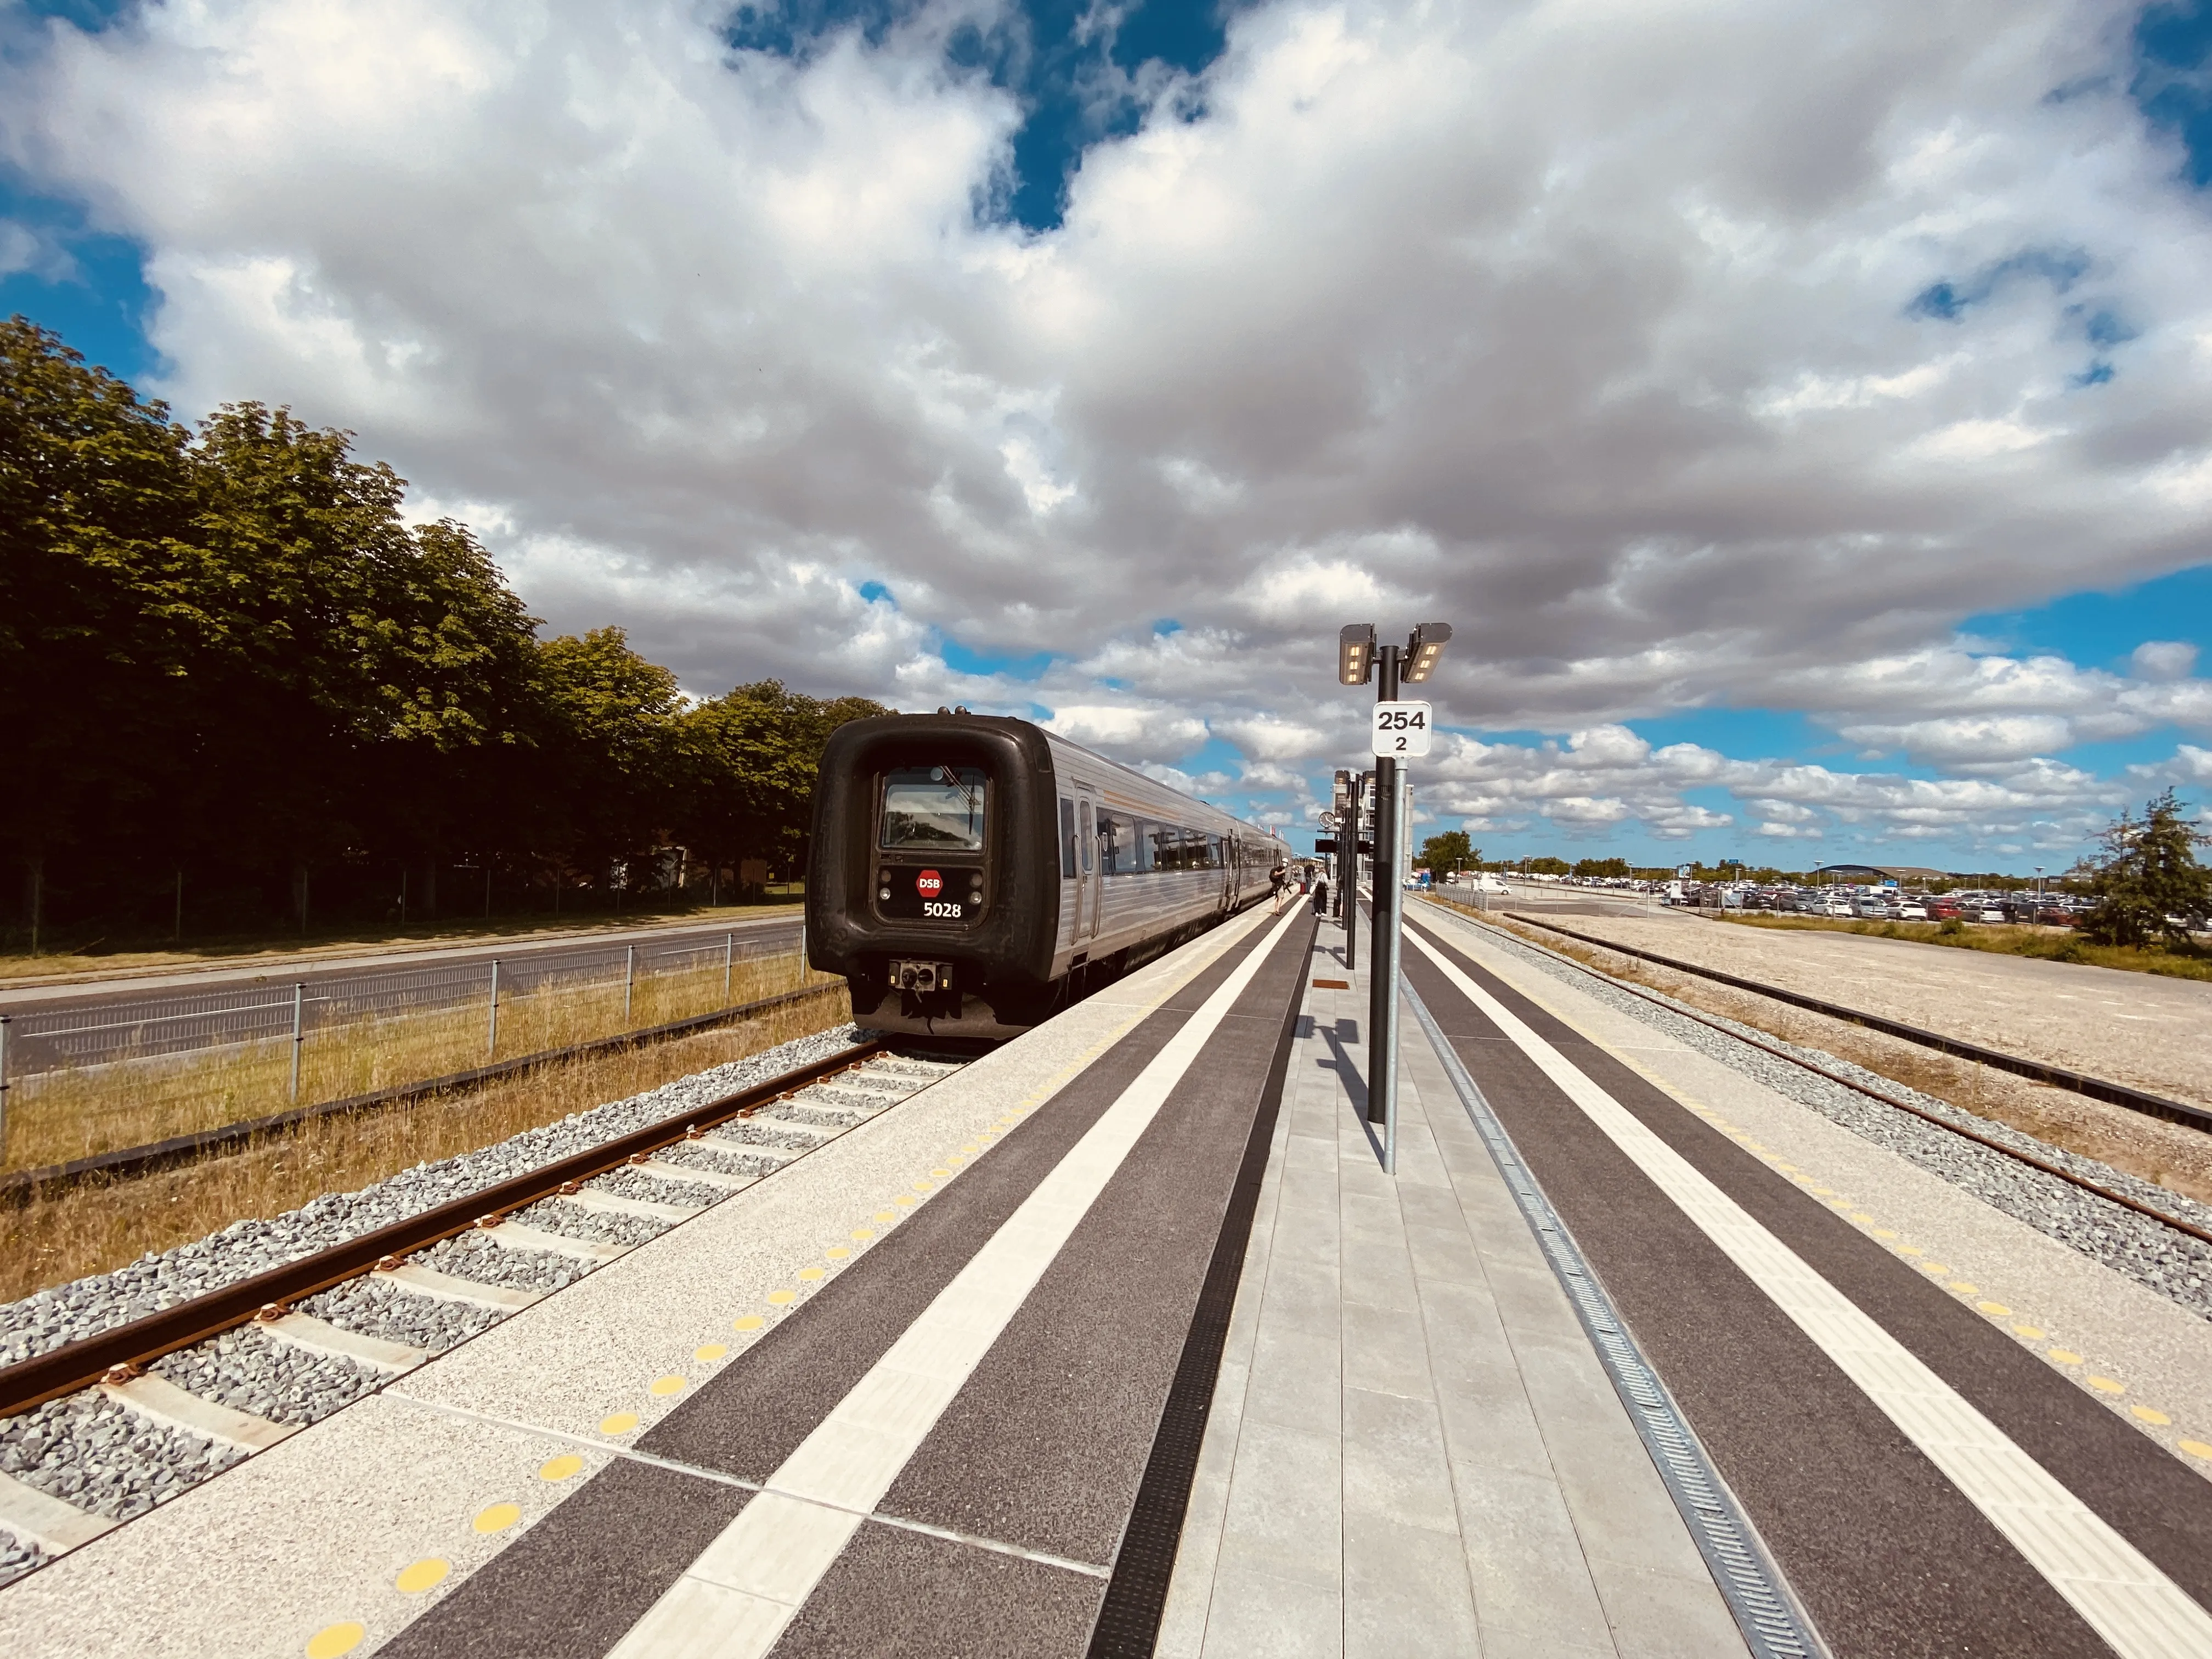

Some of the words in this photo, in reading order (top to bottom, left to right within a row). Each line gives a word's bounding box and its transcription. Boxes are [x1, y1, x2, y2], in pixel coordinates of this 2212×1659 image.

[1379, 712, 1425, 730] 254
[1396, 737, 1407, 751] 2
[919, 878, 940, 888] DSB
[924, 902, 961, 917] 5028
